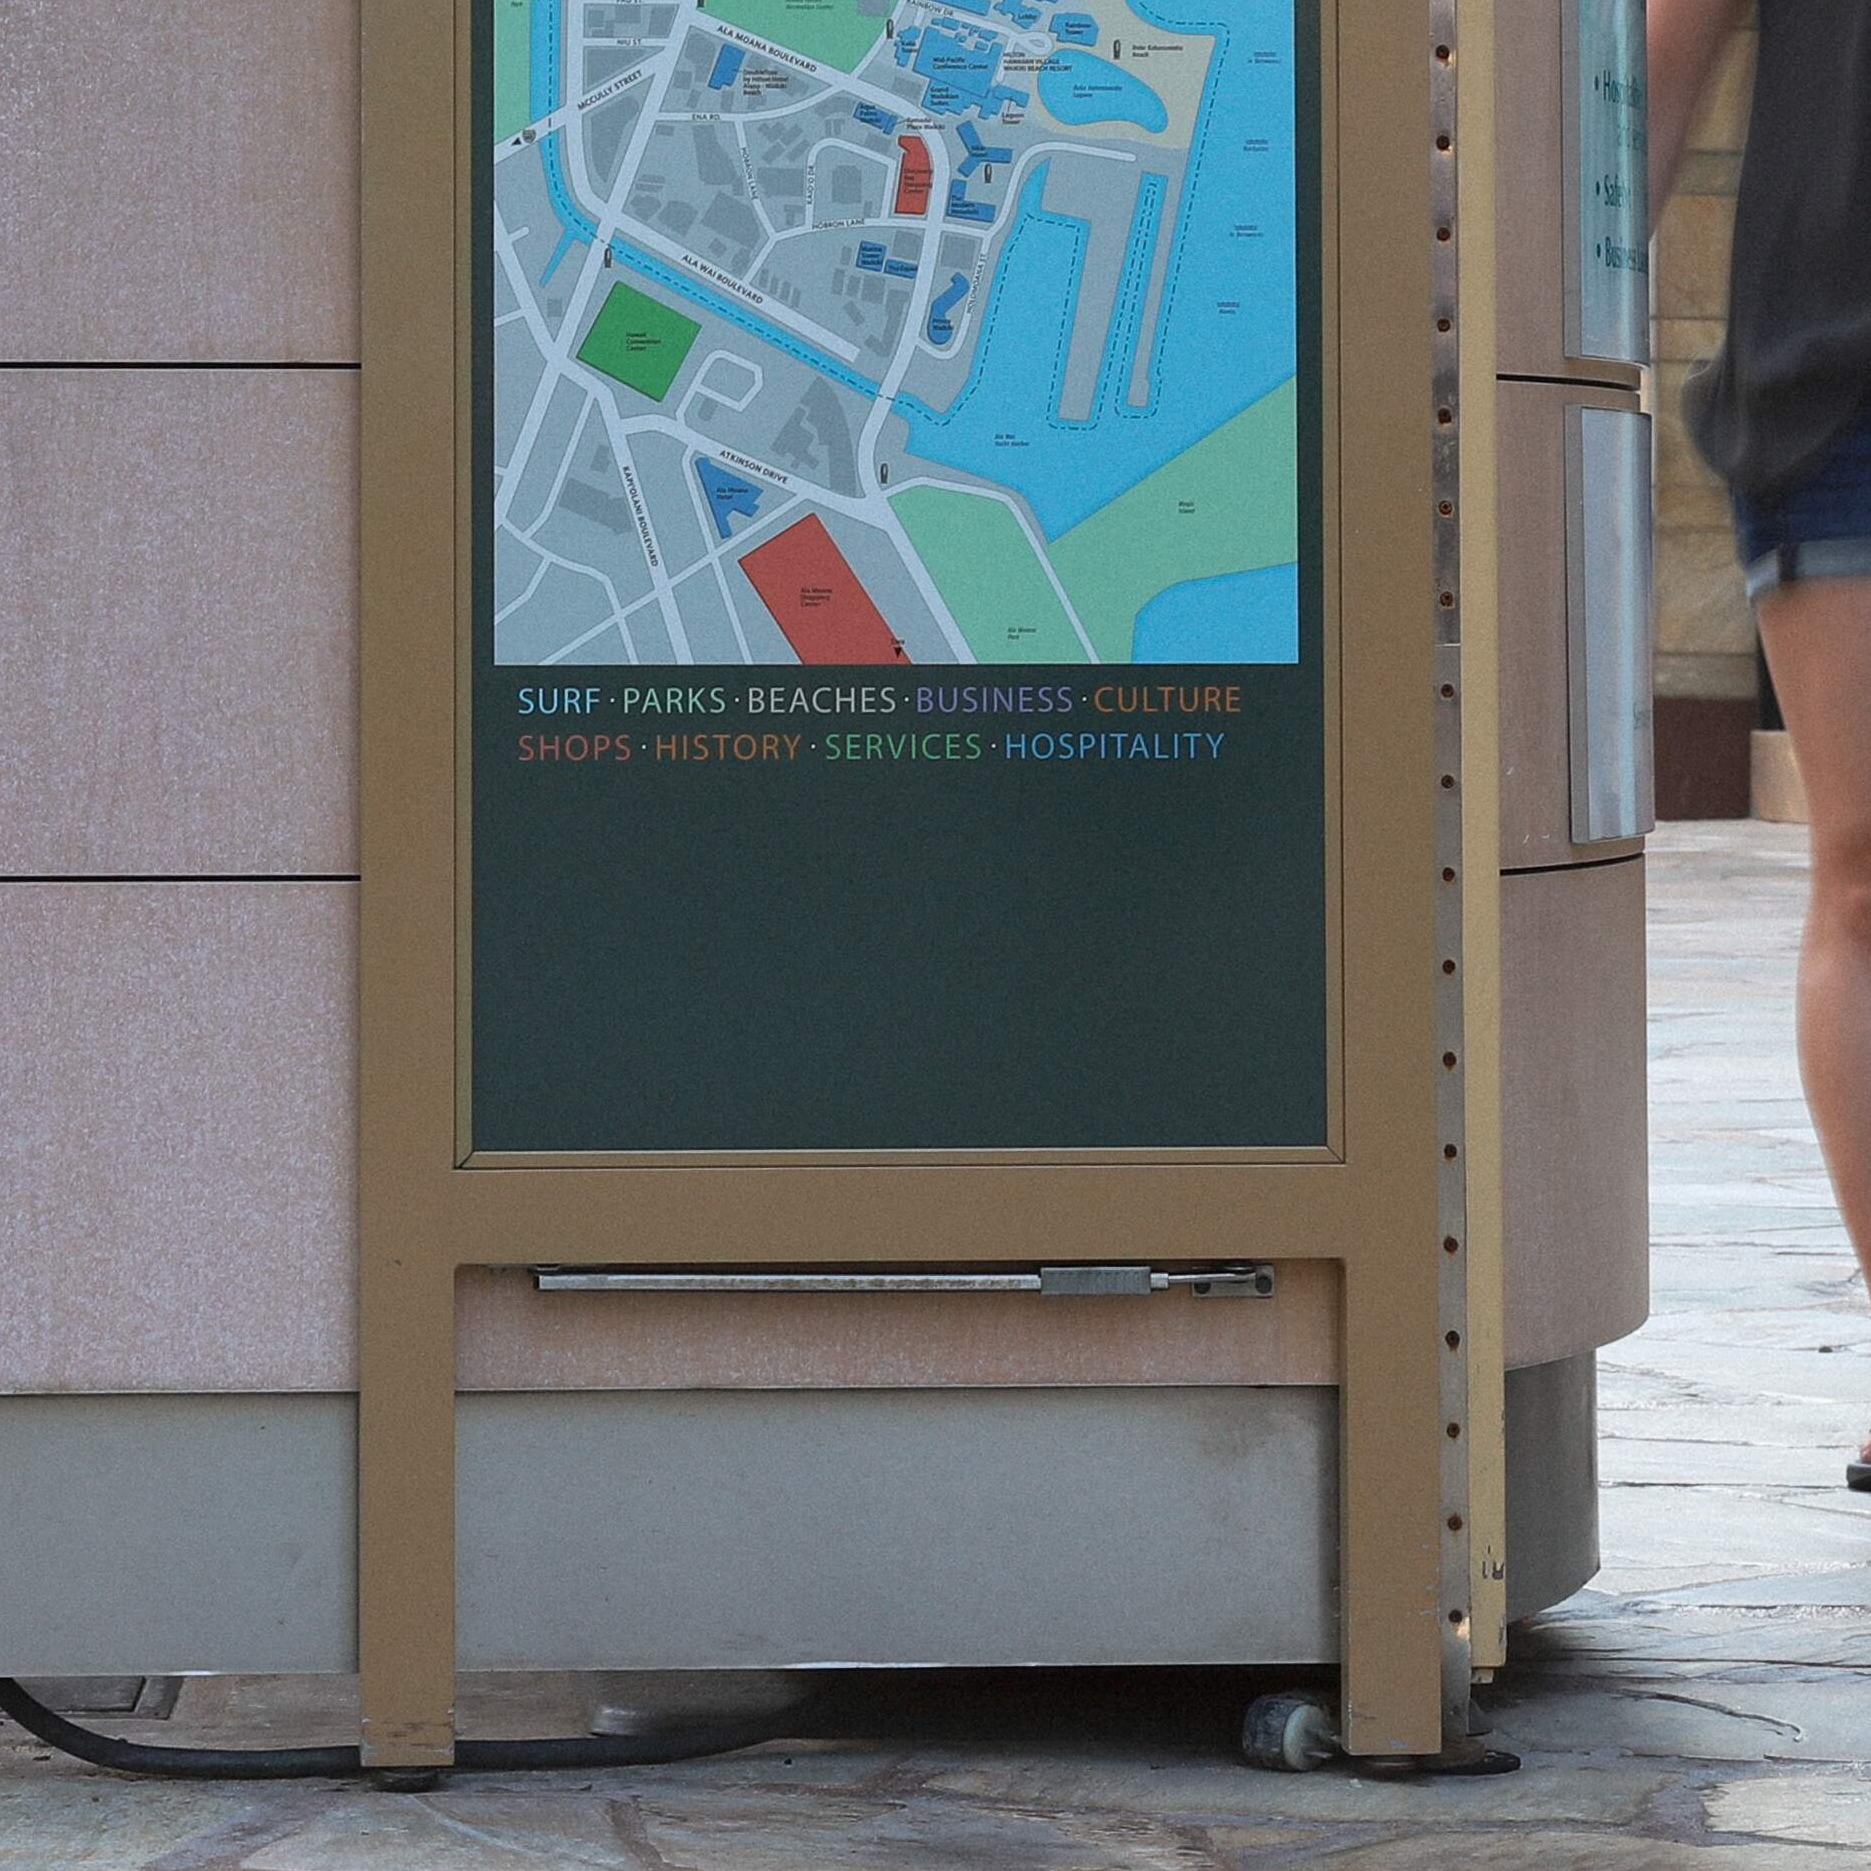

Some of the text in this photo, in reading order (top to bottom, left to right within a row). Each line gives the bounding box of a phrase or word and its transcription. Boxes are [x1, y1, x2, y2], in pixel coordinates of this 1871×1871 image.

[717, 25, 817, 73] ALA MOANA BOULEVARD
[577, 70, 643, 110] MCCULLY STREET
[846, 218, 865, 226] LANE
[682, 254, 763, 304] ALA WAI BOULEVARD
[719, 450, 788, 484] ATKINSON DRIVE
[639, 516, 658, 567] BOULEVARD
[517, 685, 1242, 715] SURF PARKS BEACHES BUSINESS CULTURE
[517, 732, 1225, 762] SHOPS HISTORY SERVICES HOSPITALITY
